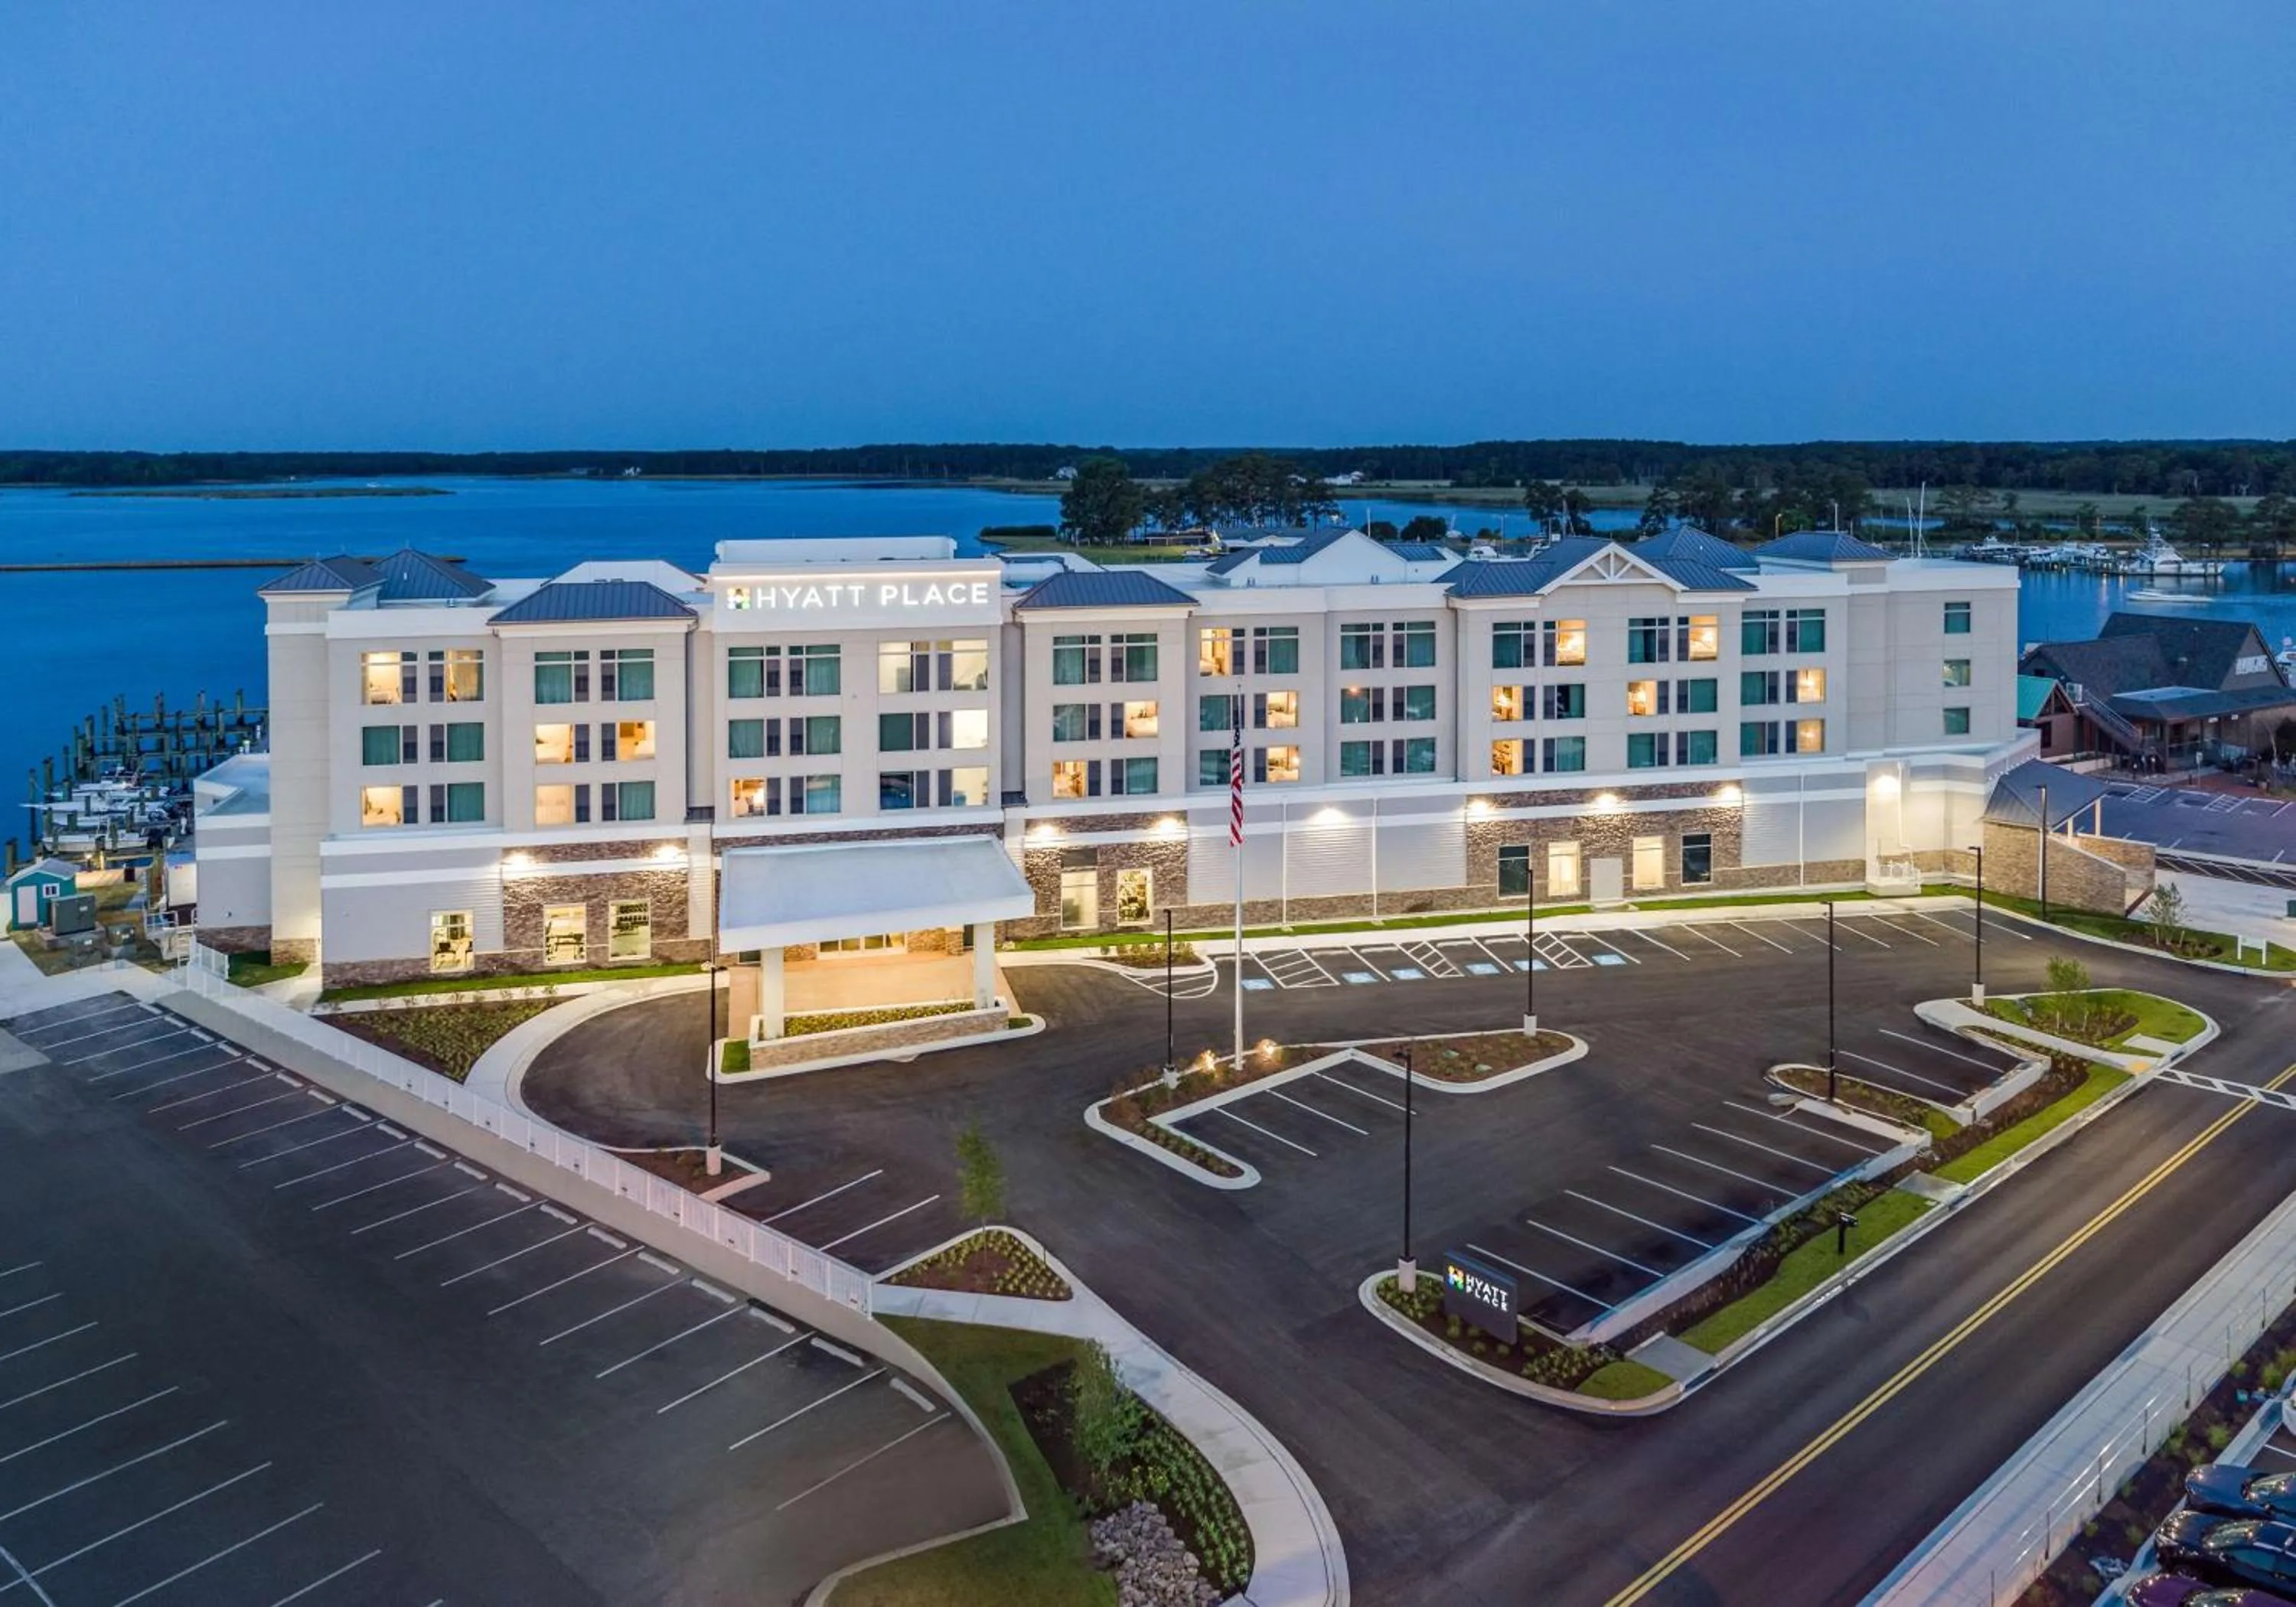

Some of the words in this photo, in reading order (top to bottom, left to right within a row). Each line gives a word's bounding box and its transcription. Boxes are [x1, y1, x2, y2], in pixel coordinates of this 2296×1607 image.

[756, 585, 866, 609] HYATT
[879, 582, 989, 606] PLACE
[1466, 1274, 1508, 1302] HYATT
[1466, 1285, 1508, 1312] PLACE
